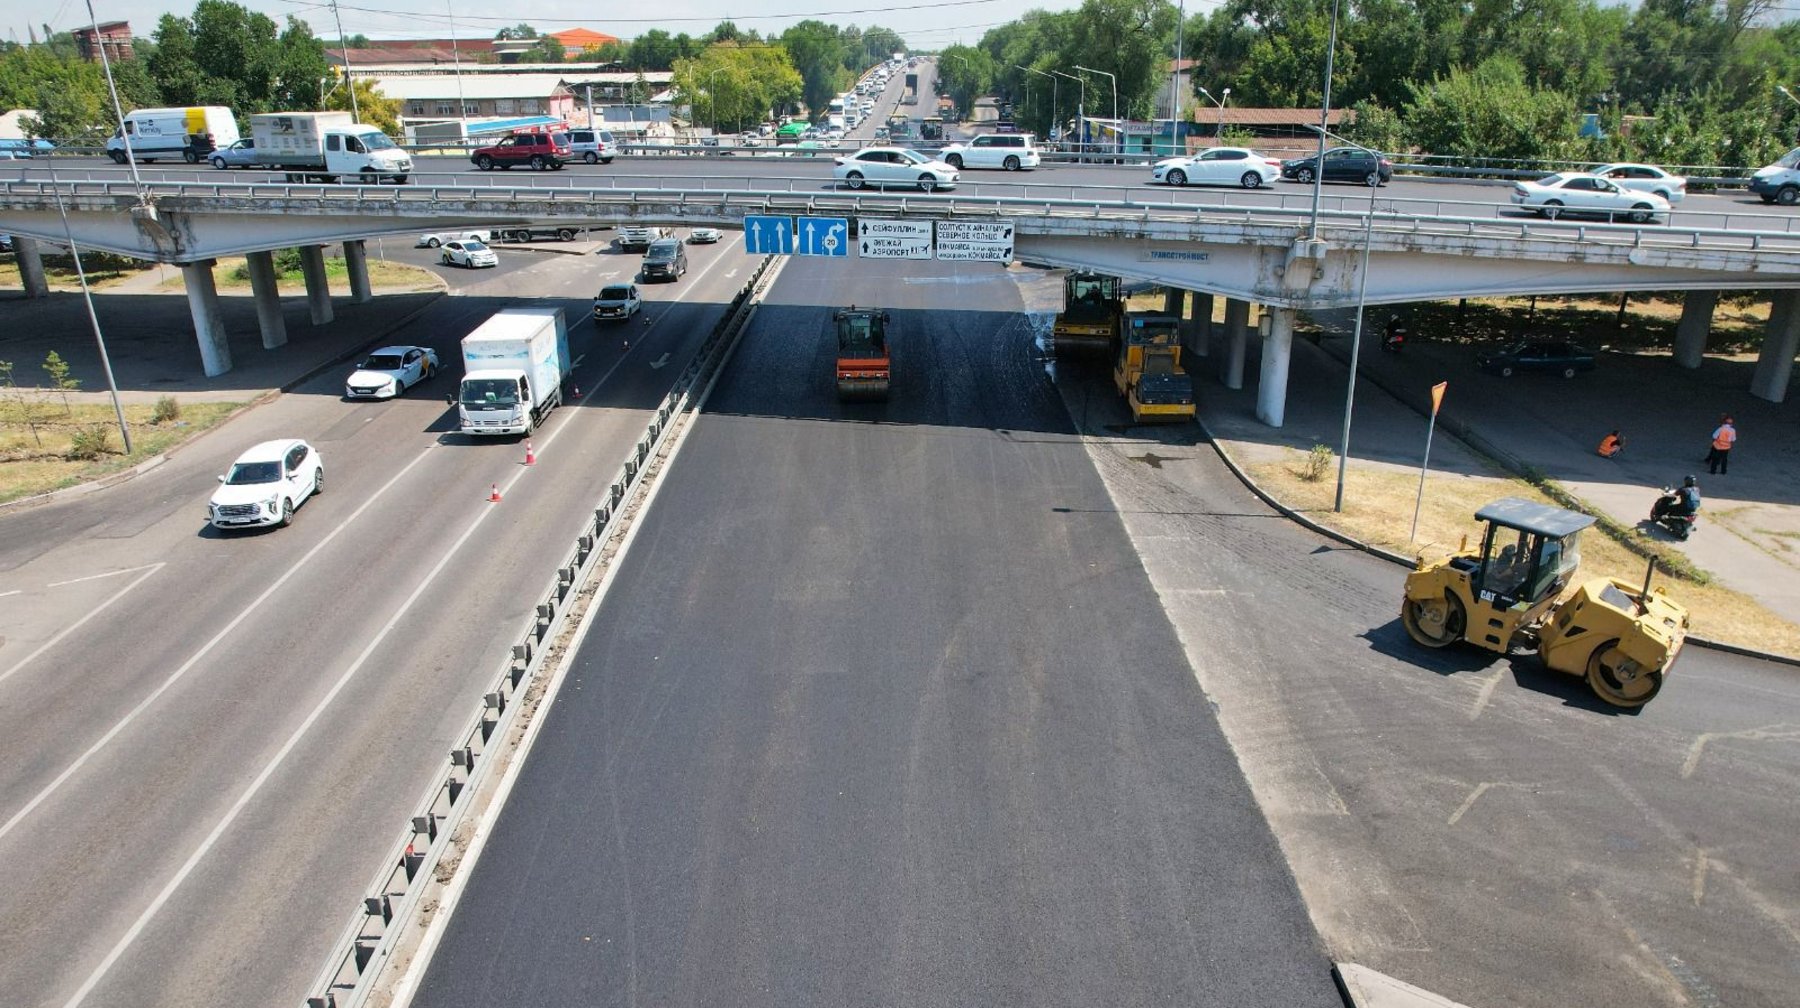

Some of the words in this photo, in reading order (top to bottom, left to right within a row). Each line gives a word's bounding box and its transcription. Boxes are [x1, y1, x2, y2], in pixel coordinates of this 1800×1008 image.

[872, 224, 916, 233] СЕЙФУЛЛИН
[938, 231, 970, 239] СЕВЕРНОЕ
[972, 232, 998, 240] КОЛЬЦО
[872, 248, 909, 256] АЭРОПОРТ
[1480, 589, 1496, 602] CAT
